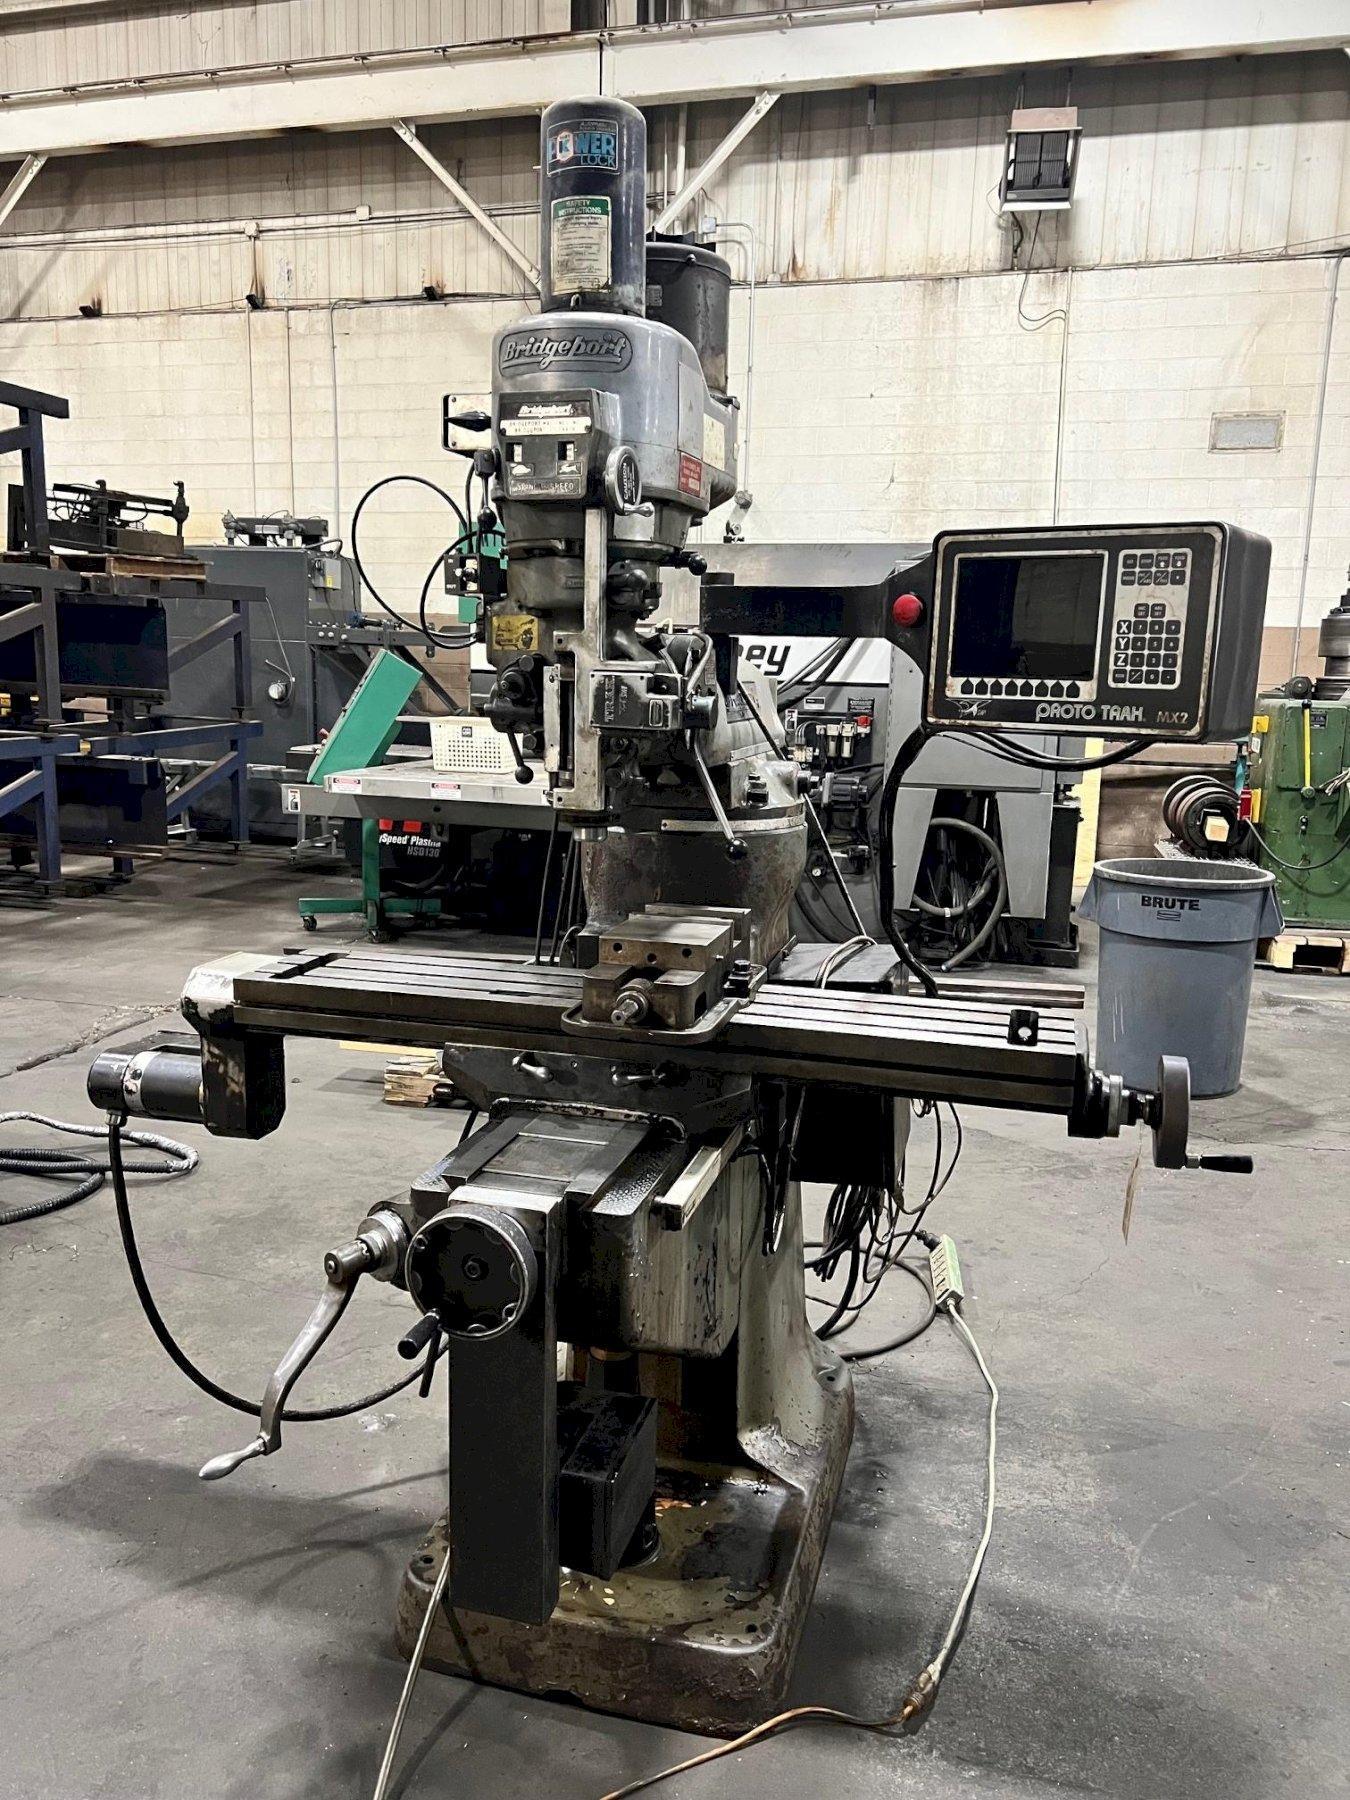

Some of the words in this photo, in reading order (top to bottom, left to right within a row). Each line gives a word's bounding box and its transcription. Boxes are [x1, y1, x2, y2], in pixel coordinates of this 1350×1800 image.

[580, 154, 616, 168] LOCK
[565, 199, 591, 207] SAFETY
[558, 206, 602, 216] INSTRUCTIONS
[503, 335, 627, 370] Bridgeport
[1119, 621, 1129, 634] X
[1118, 637, 1128, 650] Y
[1116, 653, 1126, 666] Z
[1036, 702, 1097, 723] PROTO
[1156, 710, 1189, 725] MX2
[1141, 895, 1202, 911] BRUTE
